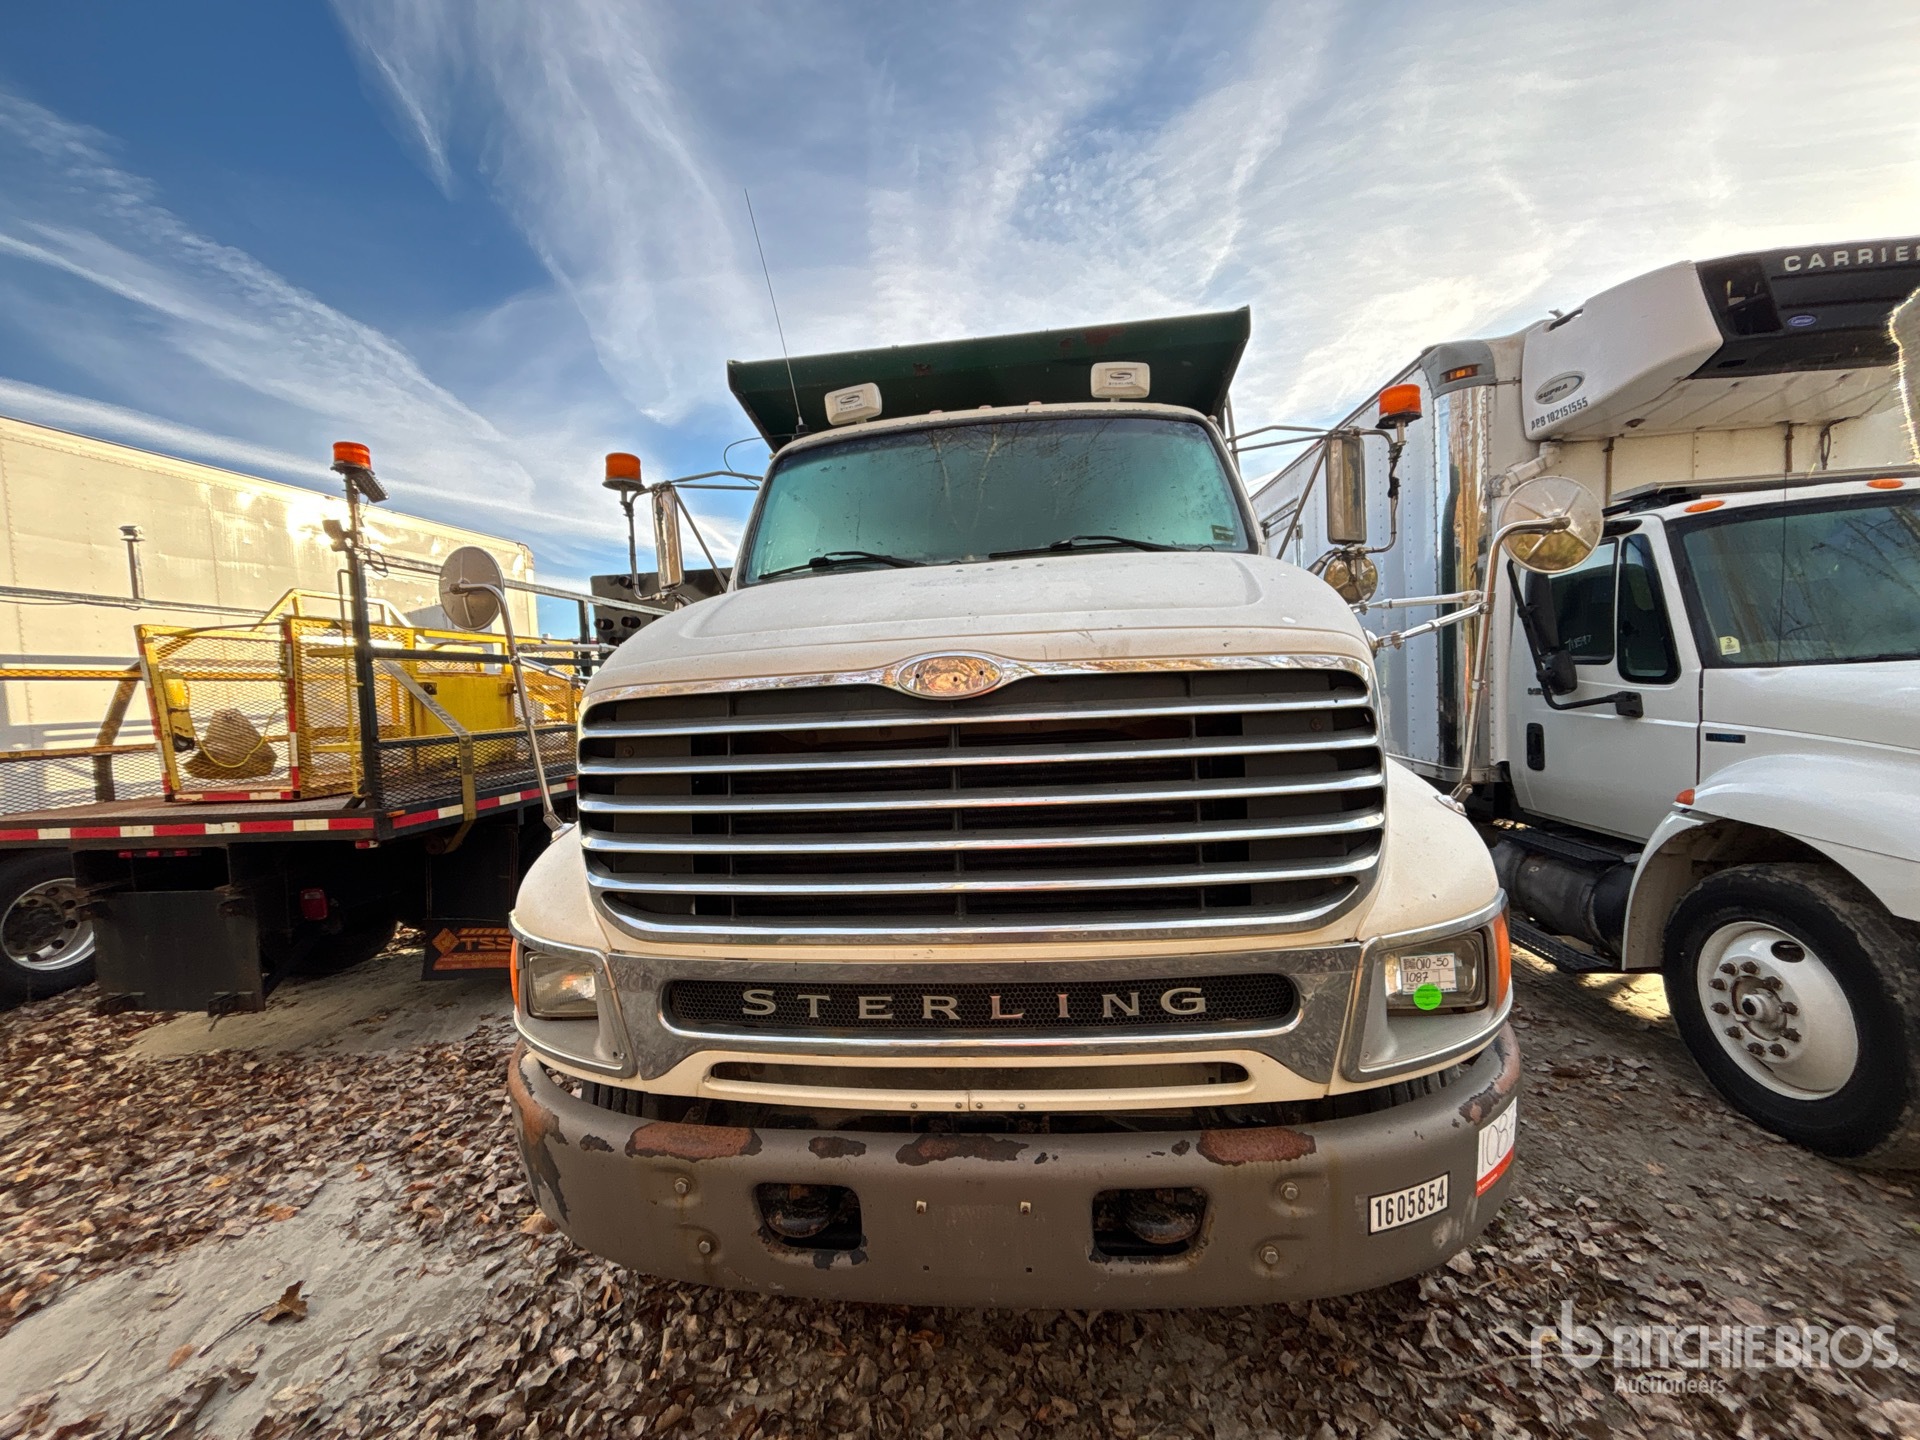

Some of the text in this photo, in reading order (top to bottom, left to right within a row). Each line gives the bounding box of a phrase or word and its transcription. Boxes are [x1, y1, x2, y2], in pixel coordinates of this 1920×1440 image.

[1537, 383, 1568, 401] SUPRA
[1546, 397, 1588, 424] 102151555
[1406, 972, 1428, 982] 1087
[742, 987, 1207, 1020] STERLING
[1375, 1180, 1445, 1227] 1605854
